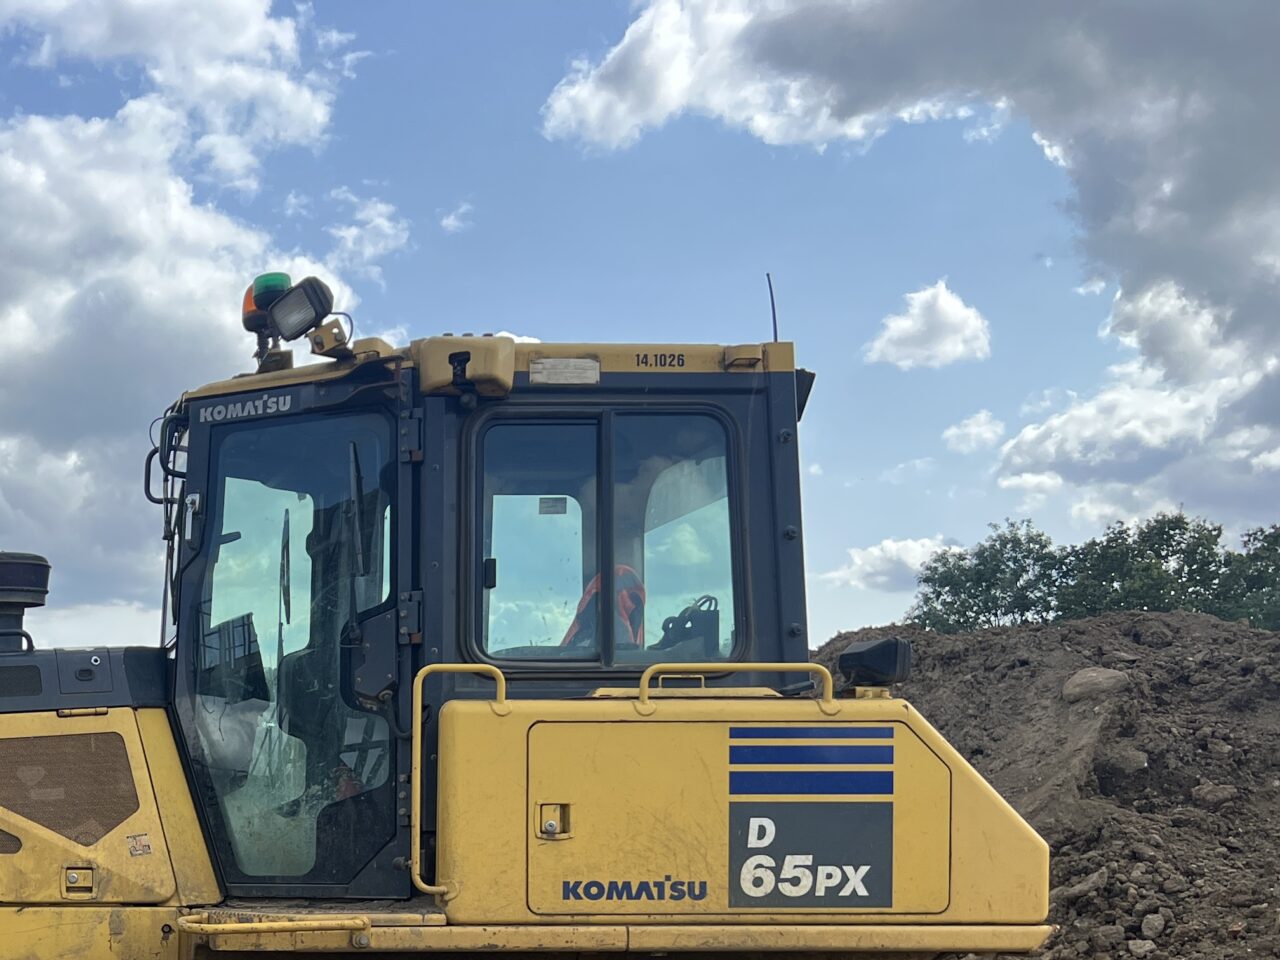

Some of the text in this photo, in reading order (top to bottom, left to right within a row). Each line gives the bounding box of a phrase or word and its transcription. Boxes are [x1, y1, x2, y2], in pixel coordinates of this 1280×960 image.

[636, 353, 685, 367] 14.1026
[200, 394, 291, 422] KOMATSU
[747, 817, 776, 848] D
[562, 875, 707, 900] KOMATSU
[740, 854, 870, 897] 65PX
